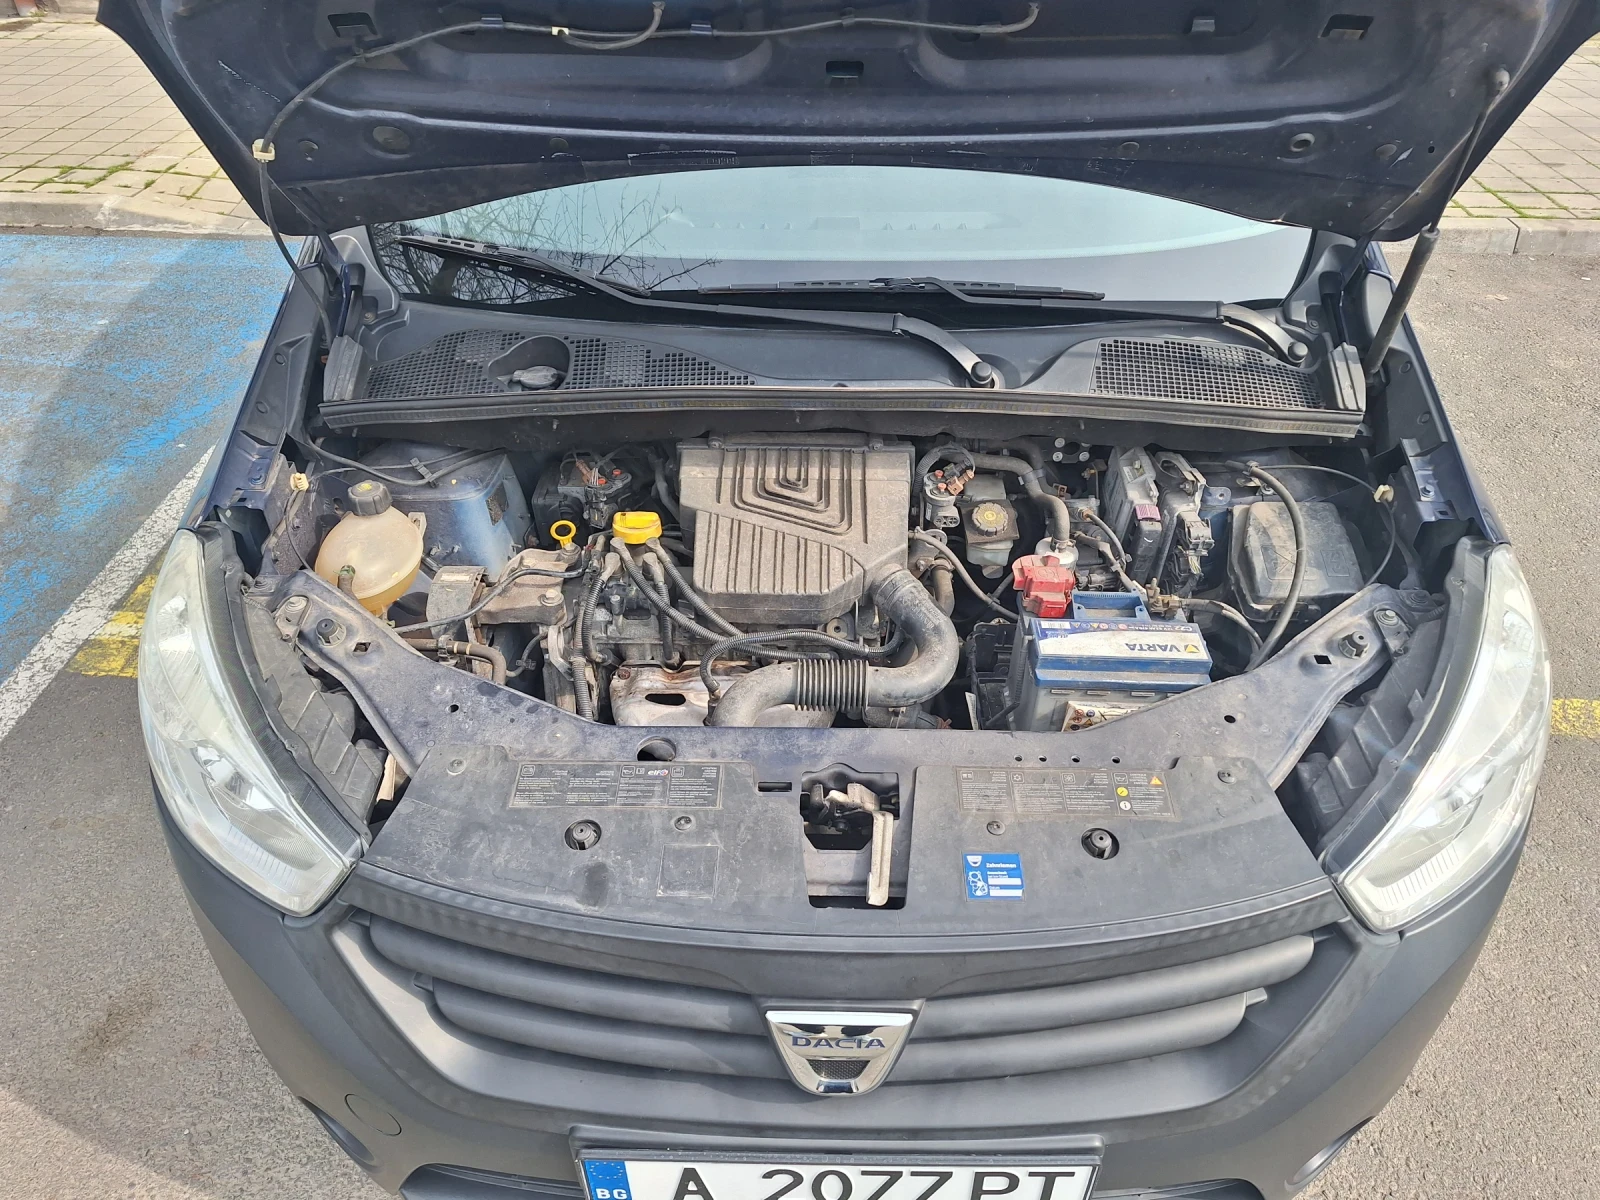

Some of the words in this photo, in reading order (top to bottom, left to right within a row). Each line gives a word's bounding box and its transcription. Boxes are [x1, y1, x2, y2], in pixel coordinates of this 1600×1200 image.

[1124, 642, 1181, 653] VARTA
[792, 1036, 886, 1049] DACIA
[672, 1167, 715, 1200] A
[761, 1169, 954, 1200] 2077
[970, 1171, 1076, 1200] PT
[595, 1188, 628, 1200] BG
